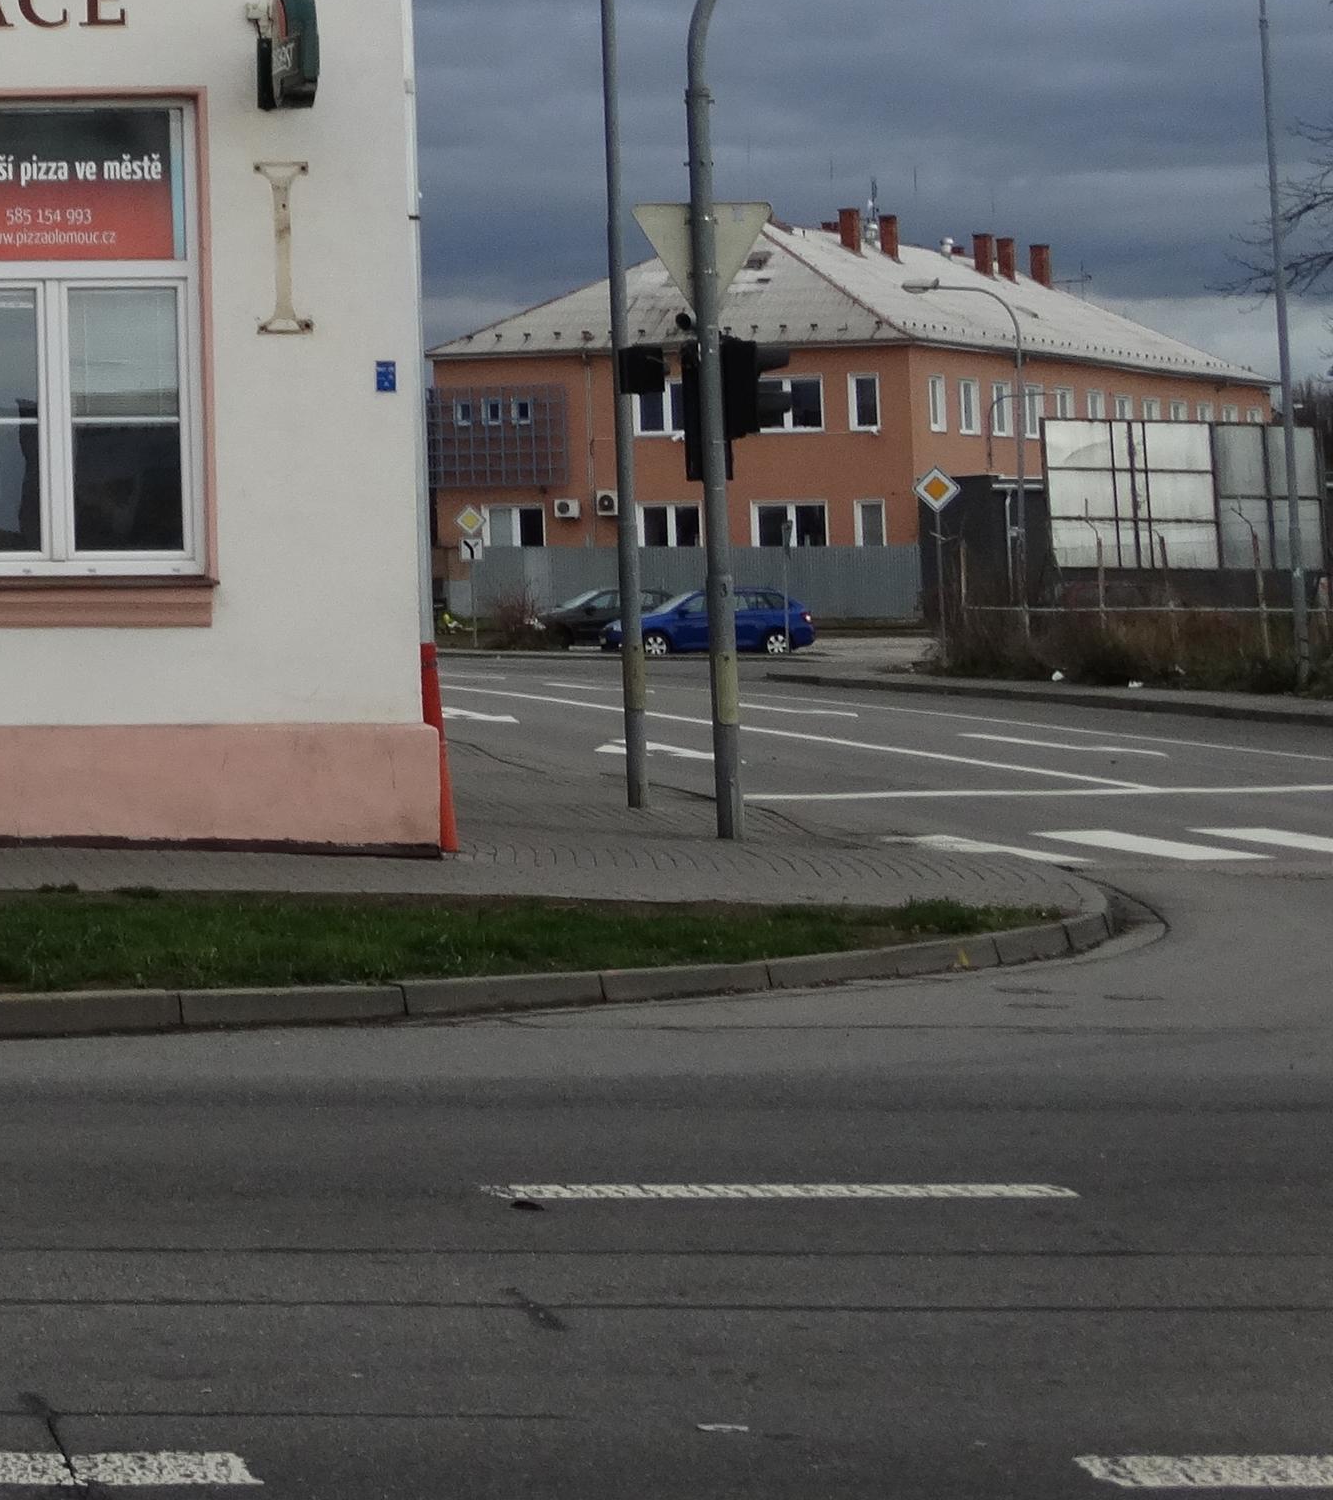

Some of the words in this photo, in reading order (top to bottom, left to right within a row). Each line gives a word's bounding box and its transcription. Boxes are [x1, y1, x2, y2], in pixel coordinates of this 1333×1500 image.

[20, 155, 69, 187] pizza
[75, 160, 97, 180] ve
[103, 153, 162, 180] městě
[6, 207, 31, 225] 585
[36, 208, 61, 224] 154
[66, 208, 92, 225] 993
